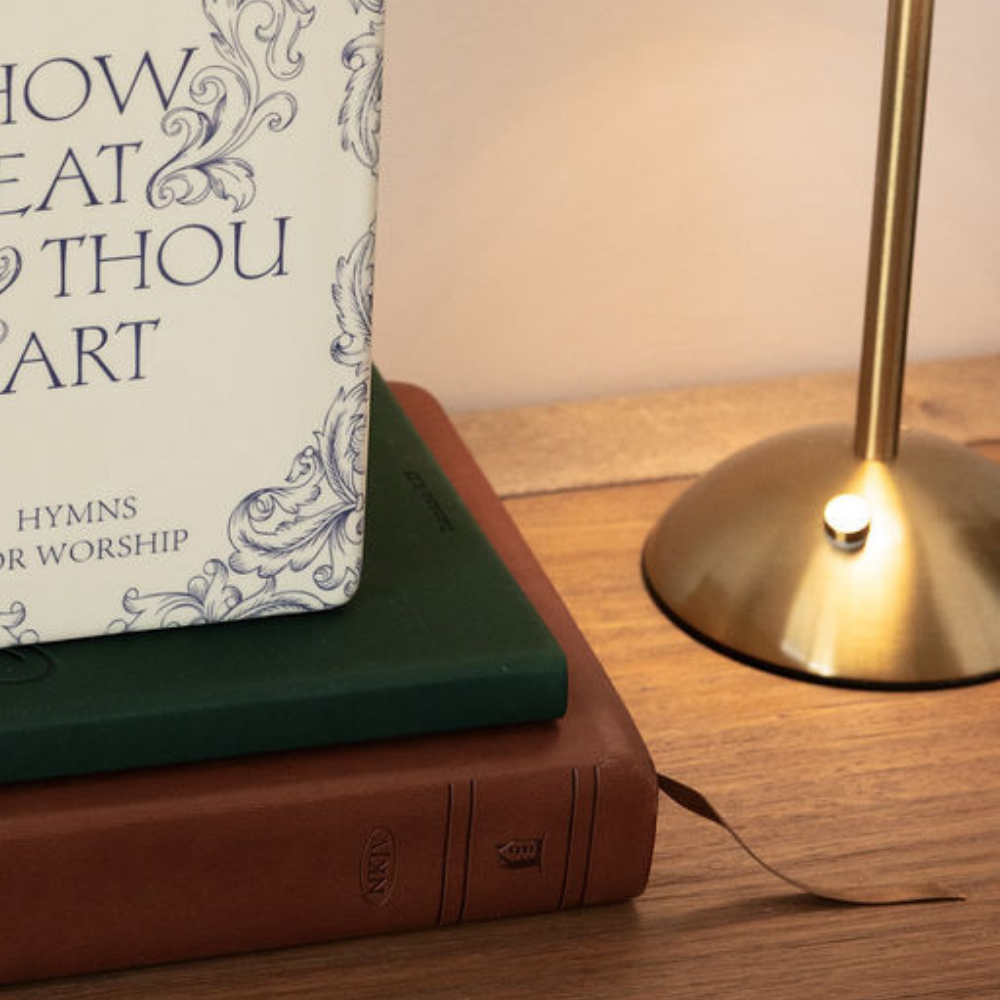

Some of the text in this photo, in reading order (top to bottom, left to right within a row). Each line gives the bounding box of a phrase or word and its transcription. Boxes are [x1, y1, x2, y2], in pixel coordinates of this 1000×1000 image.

[40, 216, 292, 298] THOU
[17, 496, 138, 531] HYMNS
[36, 529, 189, 566] WORSHIP
